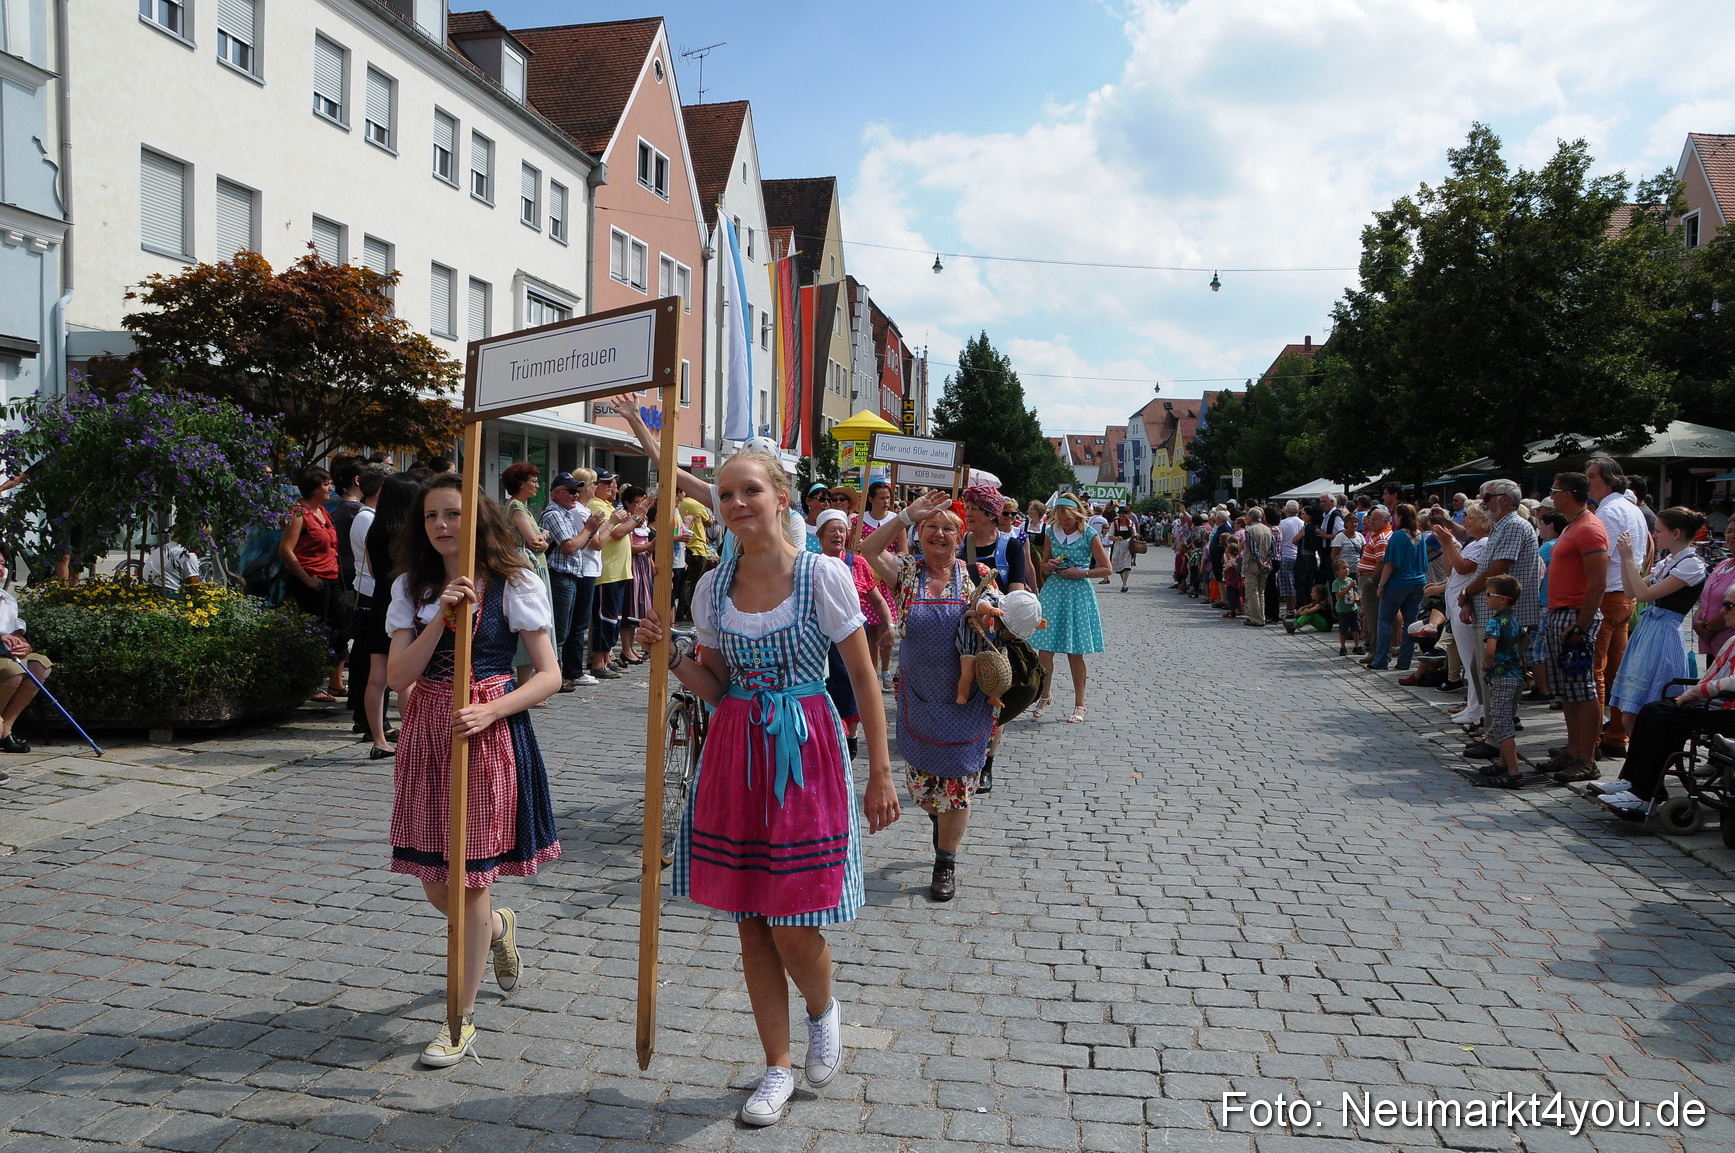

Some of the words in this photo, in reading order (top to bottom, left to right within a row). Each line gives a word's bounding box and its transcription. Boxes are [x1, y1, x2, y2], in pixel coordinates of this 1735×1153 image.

[509, 347, 617, 381] Trümmerfrauen
[880, 442, 896, 452] 50er
[898, 446, 910, 454] und
[913, 446, 928, 456] 60er
[930, 448, 949, 458] Jahre
[914, 470, 930, 478] KDFB
[931, 471, 946, 479] heute
[1097, 487, 1125, 499] DAV
